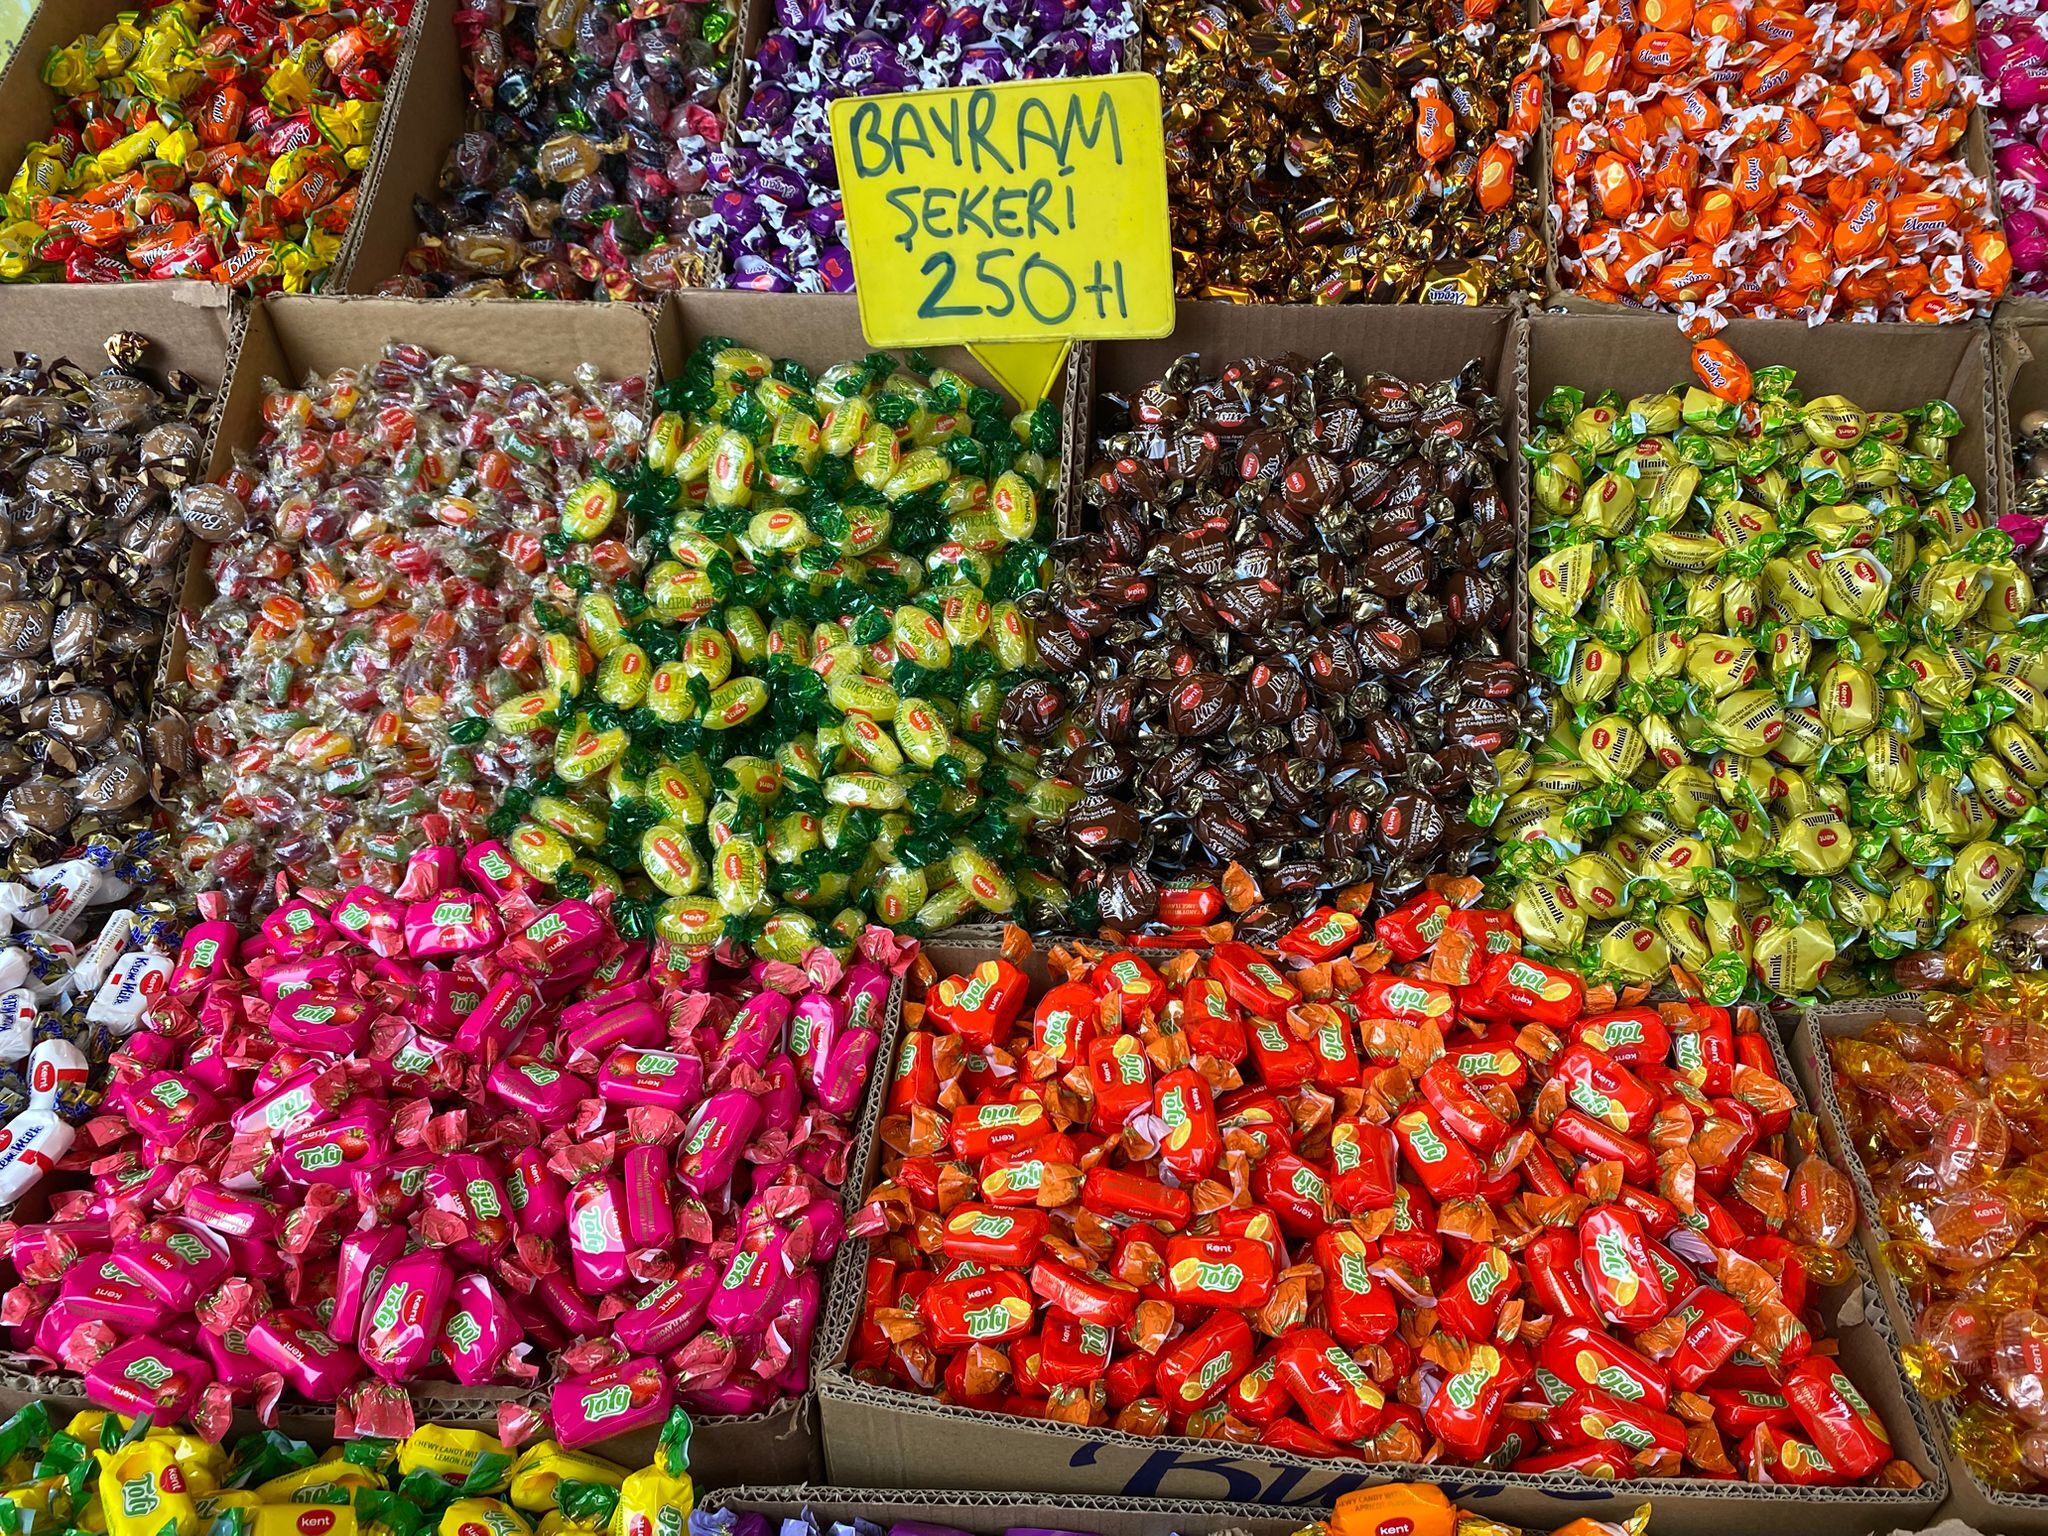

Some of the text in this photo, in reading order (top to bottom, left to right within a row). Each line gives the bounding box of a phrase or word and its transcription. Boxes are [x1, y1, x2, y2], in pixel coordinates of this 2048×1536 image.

[1638, 50, 1671, 66] Elegan
[1907, 59, 1929, 100] Elegan
[849, 89, 1123, 178] BAYRAM
[1745, 157, 1759, 192] Elegan
[886, 166, 1075, 250] ŞEKERİ
[1848, 197, 1879, 234] Elegan
[1902, 217, 1947, 234] Elegan
[1698, 351, 1727, 388] Elegan
[1244, 456, 1256, 478] kent
[1049, 629, 1083, 656] Miss
[1575, 648, 1585, 687] Fullmilk
[1589, 652, 1598, 670] kent
[1839, 685, 1850, 706] kent
[912, 711, 928, 730] kent
[1192, 698, 1224, 729] Miss
[1085, 765, 1123, 786] Miss
[1425, 804, 1444, 842] Miss
[478, 850, 511, 881] Tofy
[729, 856, 738, 879] kent
[1981, 866, 2016, 902] Fullmilk
[338, 903, 370, 930] Tofy
[432, 902, 472, 925] Tofy
[1411, 902, 1428, 915] kent
[1535, 882, 1564, 923] Fullmilk
[525, 913, 567, 941] Tofy
[1308, 919, 1346, 946] Tofy
[190, 938, 219, 968] Tofy
[1111, 960, 1141, 985] Tofy
[1248, 963, 1283, 988] Tofy
[1508, 963, 1548, 995] Tofy
[493, 990, 512, 1016] kent
[959, 977, 990, 1012] Tofy
[988, 992, 1002, 1011] kent
[292, 1003, 336, 1023] Tofy
[500, 994, 532, 1031] Tofy
[790, 1015, 812, 1056] Tofy
[1603, 1020, 1644, 1047] Tofy
[636, 1054, 679, 1076] Tofy
[1460, 1052, 1500, 1077] Tofy
[1676, 1032, 1703, 1070] Tofy
[1710, 1038, 1720, 1064] kent
[39, 1064, 48, 1088] kent
[1118, 1053, 1145, 1085] Tofy
[1593, 1070, 1617, 1090] kent
[265, 1089, 312, 1128] Tofy
[1161, 1085, 1187, 1127] Tofy
[1191, 1087, 1200, 1111] kent
[978, 1104, 1020, 1125] Tofy
[16, 1125, 45, 1156] Milk
[300, 1127, 330, 1140] kent
[712, 1125, 726, 1148] kent
[991, 1133, 1015, 1143] kent
[1410, 1122, 1447, 1163] Tofy
[1950, 1122, 1967, 1148] kent
[294, 1143, 343, 1171] Tofy
[528, 1163, 542, 1185] kent
[466, 1179, 501, 1221] Tofy
[506, 1168, 529, 1210] Tofy
[1799, 1183, 1808, 1207] kent
[971, 1214, 1015, 1239] Tofy
[1973, 1206, 2003, 1219] kent
[577, 1205, 607, 1255] Tofy
[151, 1252, 173, 1270] kent
[165, 1233, 212, 1265] Tofy
[1206, 1243, 1232, 1253] kent
[1596, 1230, 1630, 1282] Tofy
[1633, 1235, 1648, 1268] kent
[722, 1251, 757, 1290] Tofy
[752, 1261, 768, 1287] kent
[1196, 1261, 1244, 1293] Tofy
[1340, 1251, 1372, 1295] Tofy
[1467, 1261, 1502, 1305] Tofy
[94, 1287, 124, 1301] kent
[374, 1281, 408, 1331] Tofy
[966, 1285, 993, 1299] kent
[409, 1295, 424, 1323] kent
[964, 1304, 1010, 1339] Tofy
[446, 1311, 482, 1354] Tofy
[1687, 1325, 1710, 1347] kent
[124, 1355, 173, 1390] Tofy
[1200, 1350, 1233, 1390] Tofy
[1325, 1347, 1368, 1388] Tofy
[2034, 1343, 2044, 1374] kent
[590, 1372, 617, 1385] kent
[1318, 1370, 1342, 1394] kent
[1447, 1369, 1490, 1410] Tofy
[1597, 1365, 1645, 1401] Tofy
[581, 1384, 632, 1422] Tofy
[1484, 1392, 1499, 1417] kent
[1828, 1391, 1853, 1420] kent
[414, 1439, 478, 1460] CHEWY CANDY WIT
[1605, 1421, 1656, 1450] Tofy
[434, 1453, 461, 1465] LEMON
[167, 1467, 180, 1492] kent
[120, 1471, 161, 1519] Tofy
[301, 1515, 330, 1528] kent
[1380, 1524, 1409, 1536] kent
